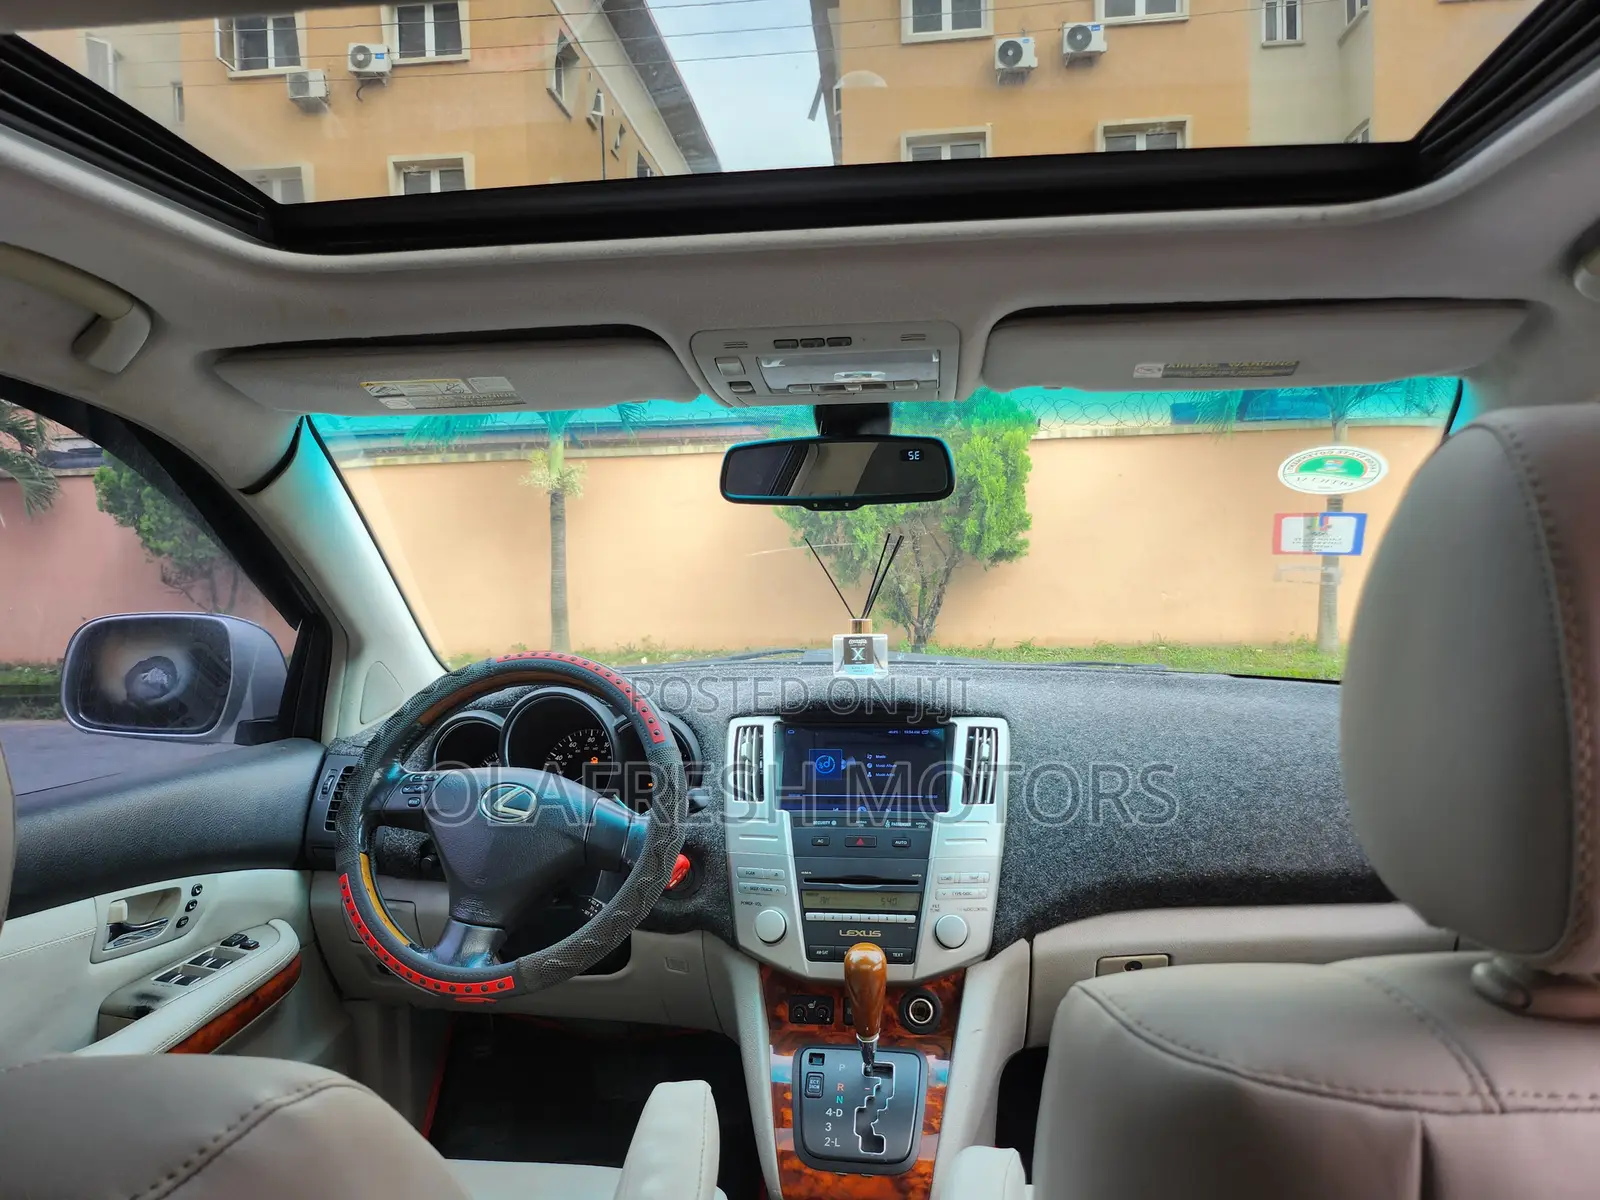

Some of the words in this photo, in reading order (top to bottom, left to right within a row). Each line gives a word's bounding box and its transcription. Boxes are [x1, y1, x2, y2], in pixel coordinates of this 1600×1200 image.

[850, 647, 866, 661] X
[839, 929, 882, 937] LEXUS
[837, 1083, 845, 1091] R
[836, 1096, 845, 1104] N
[825, 1108, 844, 1117] 4-D
[825, 1122, 832, 1132] 3
[824, 1137, 841, 1147] 2-L
